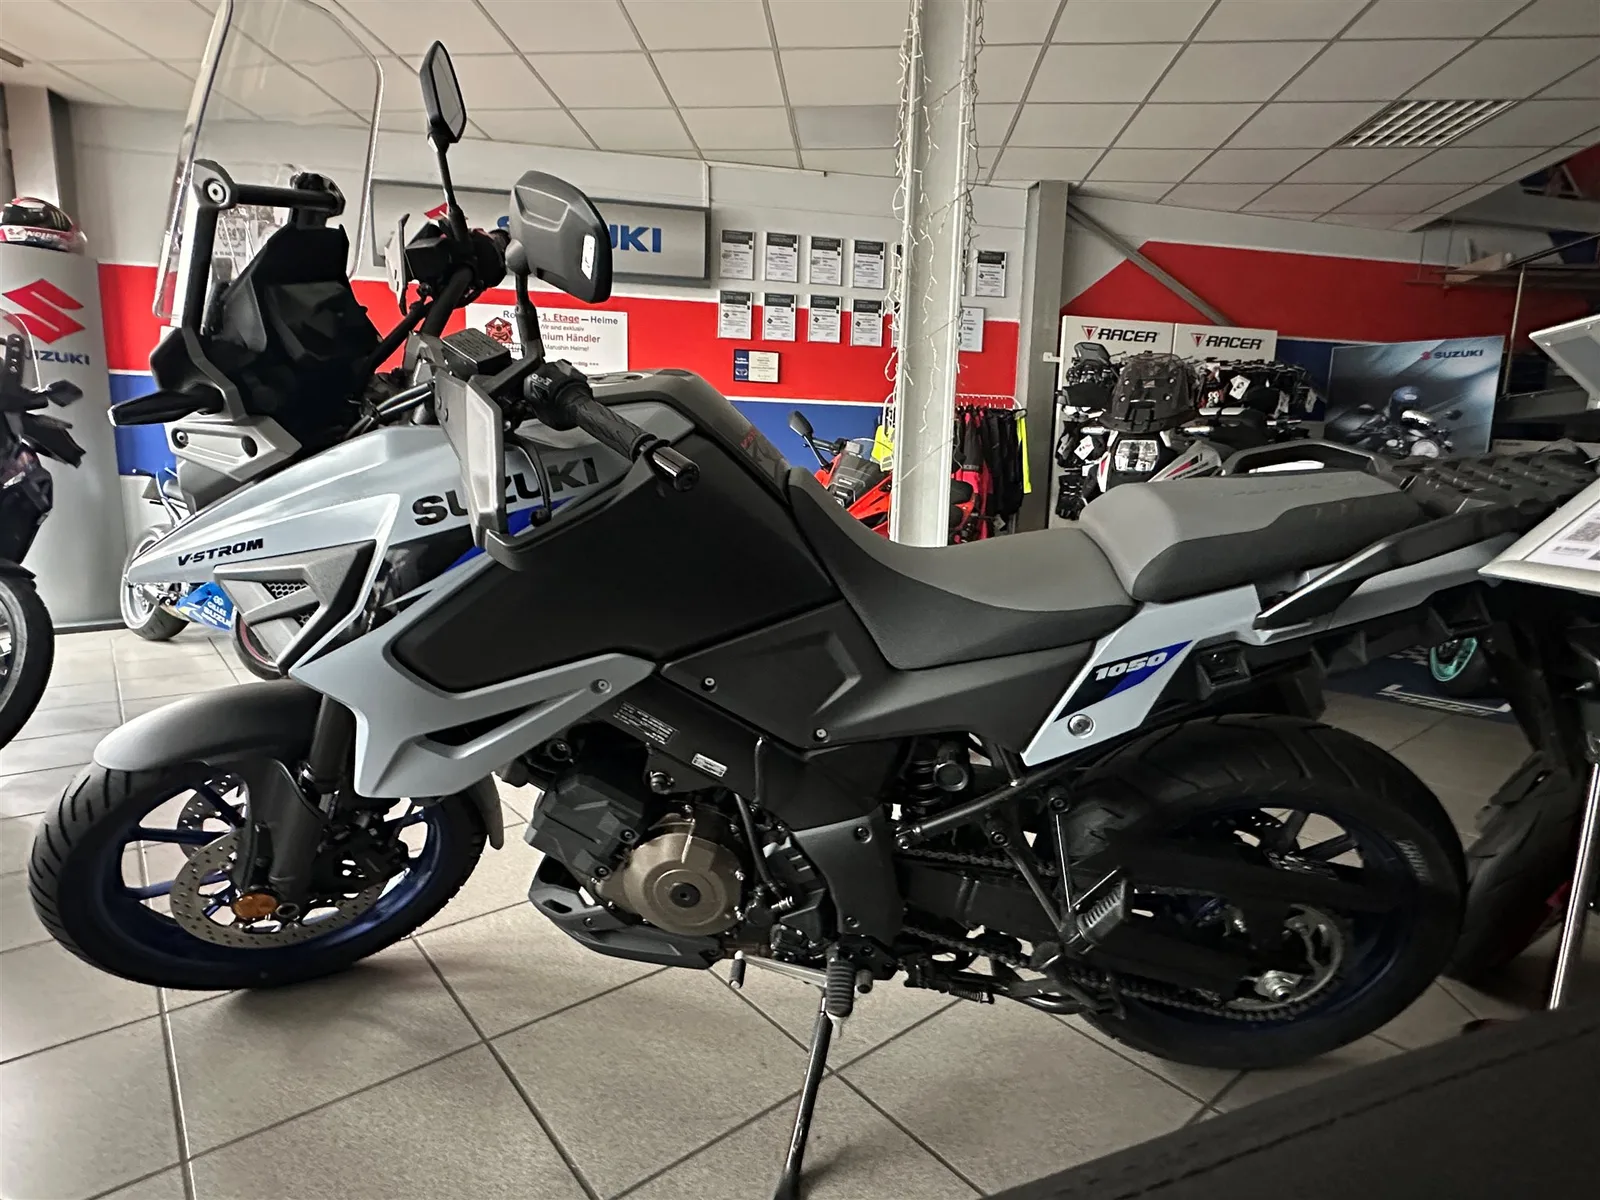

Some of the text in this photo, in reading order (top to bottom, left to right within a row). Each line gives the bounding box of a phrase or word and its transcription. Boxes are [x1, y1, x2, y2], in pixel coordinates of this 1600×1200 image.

[553, 313, 580, 324] Etage
[590, 316, 619, 324] Helme
[566, 333, 601, 343] Händler
[1098, 328, 1158, 343] RACER
[1205, 335, 1263, 350] RACER
[25, 350, 90, 365] UZUKI
[1434, 349, 1484, 359] SUZUKI
[178, 538, 264, 567] V-STROM
[1095, 652, 1168, 681] 1050
